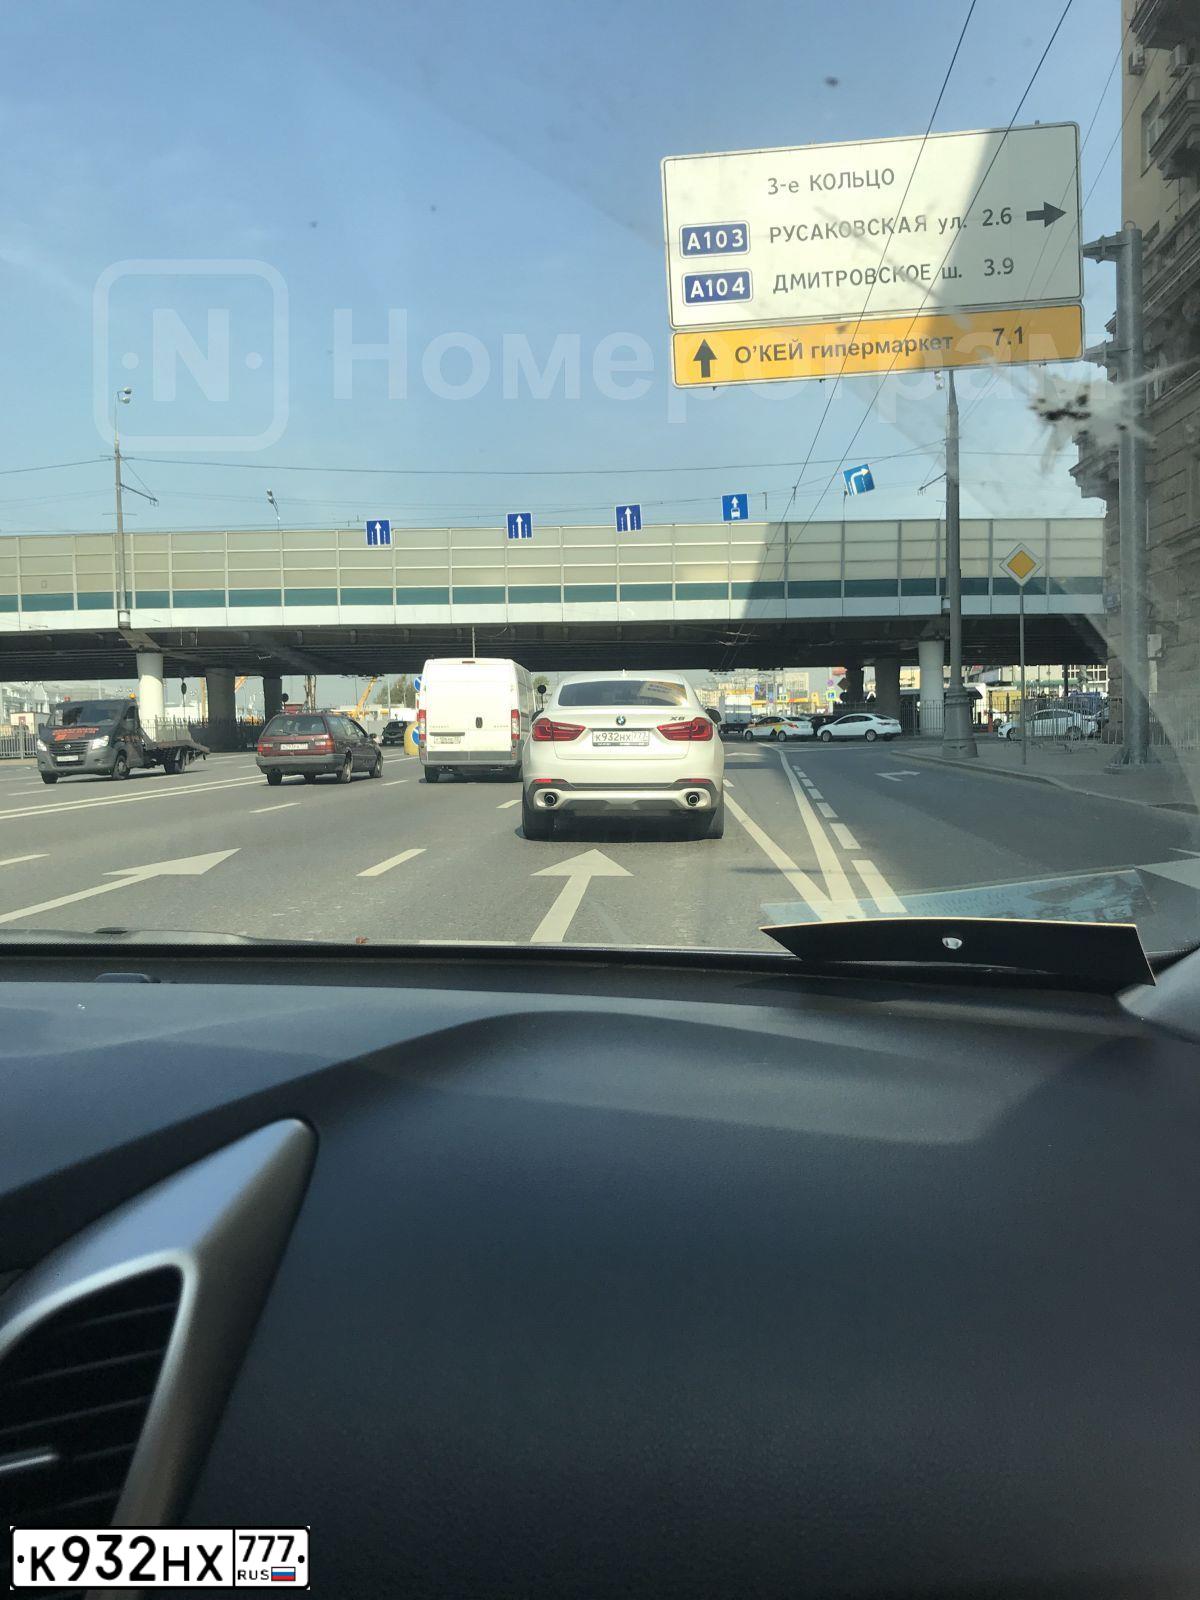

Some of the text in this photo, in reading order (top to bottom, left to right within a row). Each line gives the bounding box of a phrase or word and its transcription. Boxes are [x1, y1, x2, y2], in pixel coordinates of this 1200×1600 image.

[767, 167, 895, 195] 3-е КОЛЬЦО
[686, 228, 745, 250] А103
[769, 207, 1013, 243] РУСАКОВСКАЯ ул. 2.6
[689, 277, 746, 298] А104
[772, 256, 1014, 294] ДМИТРОВСКОЕ ш. 3.9
[810, 335, 954, 359] гипермаркет
[991, 326, 1025, 346] 7.1
